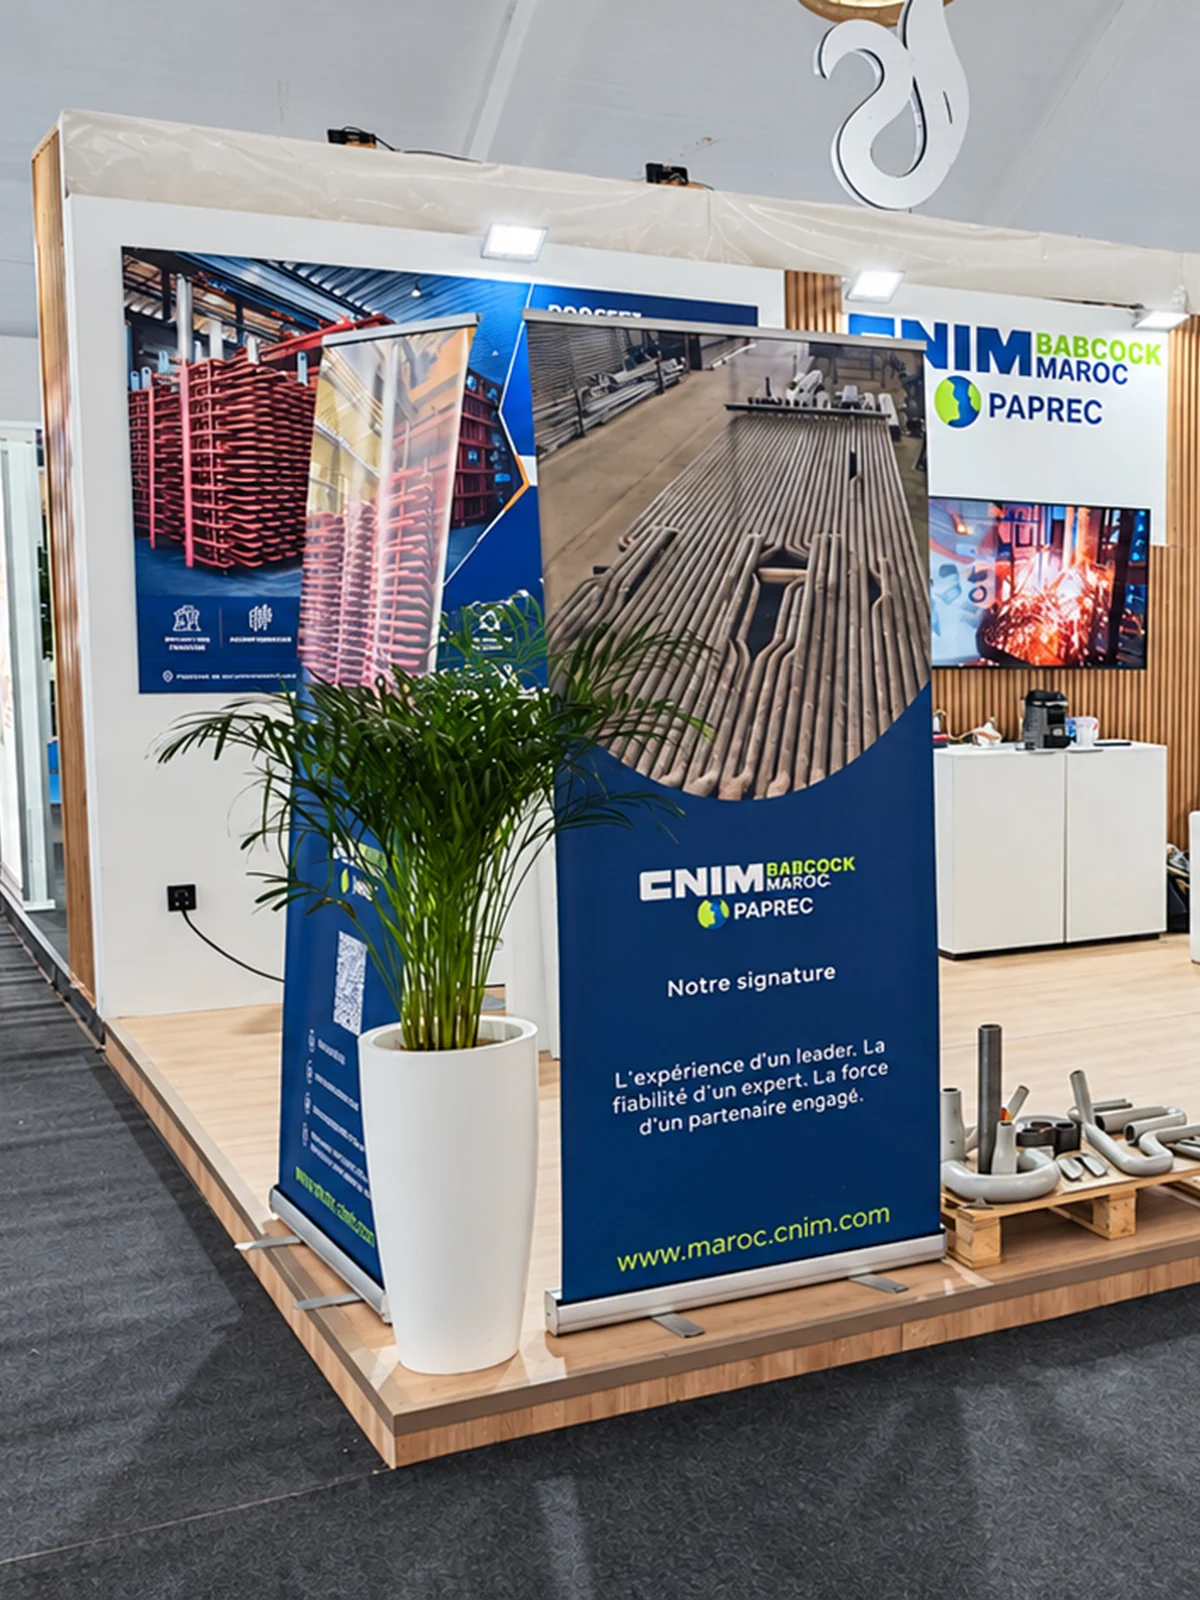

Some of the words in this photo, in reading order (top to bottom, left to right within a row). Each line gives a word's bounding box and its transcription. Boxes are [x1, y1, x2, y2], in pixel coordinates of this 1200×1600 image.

[1036, 332, 1162, 366] BABCOCK
[1036, 357, 1128, 385] MAROC
[989, 392, 1103, 425] PAPREC
[638, 863, 765, 902] CNIM
[766, 856, 856, 877] BABCOCK
[766, 873, 832, 892] MAROC
[733, 897, 814, 920] PAPREC
[667, 976, 731, 998] Notre
[736, 965, 836, 992] signature
[615, 1058, 745, 1089] L'expérience
[749, 1049, 791, 1070] d'un
[796, 1044, 857, 1064] leader.
[863, 1038, 886, 1055] La
[612, 1087, 688, 1115] fiabilité
[693, 1081, 737, 1103] d'un
[741, 1075, 809, 1099] expert.
[813, 1068, 836, 1085] La
[841, 1060, 889, 1080] force
[638, 1113, 683, 1137] d'un
[688, 1099, 787, 1132] partenaire
[792, 1089, 865, 1115] engagé.
[616, 1206, 891, 1273] www.maroc.cnim.com
